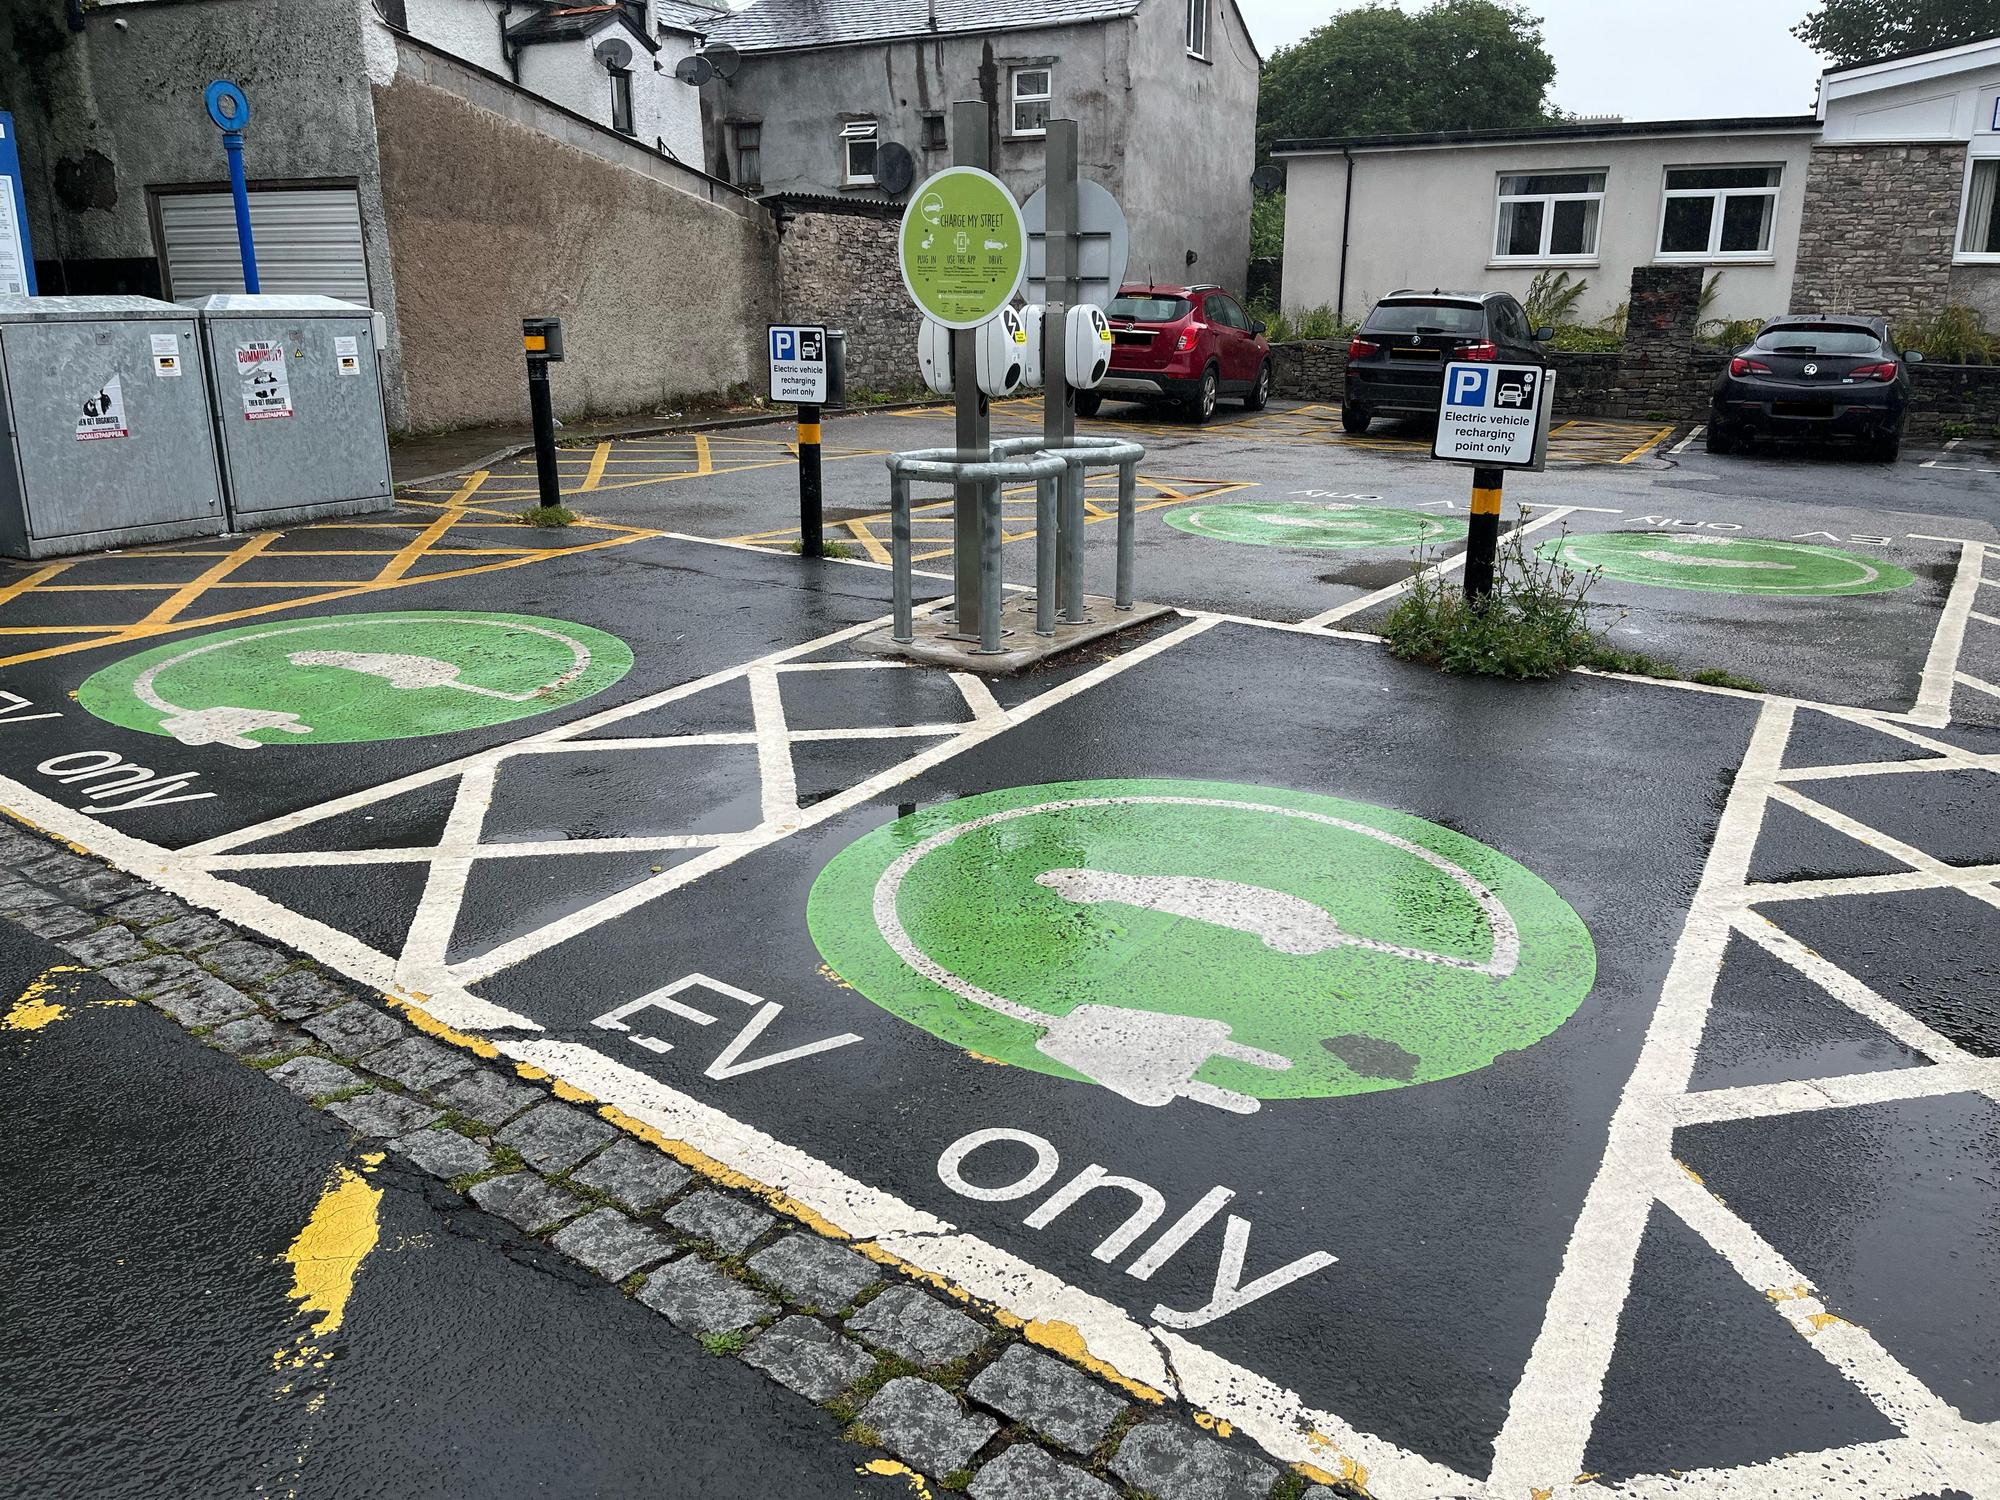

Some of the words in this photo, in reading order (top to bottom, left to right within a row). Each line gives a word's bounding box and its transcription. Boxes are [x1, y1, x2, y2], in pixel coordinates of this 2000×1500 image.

[940, 214, 966, 228] CHARGE
[967, 214, 979, 228] MY
[980, 213, 1004, 228] STREET
[930, 255, 937, 265] IN
[988, 255, 1004, 265] DRIVE
[776, 333, 791, 358] P
[773, 365, 799, 373] Electric
[800, 366, 823, 374] vehicle
[781, 376, 816, 386] recharging
[1454, 371, 1482, 403] P
[782, 388, 799, 396] point
[800, 388, 815, 397] only
[1445, 411, 1487, 423] Electric
[1490, 414, 1530, 426] vehicle
[1455, 427, 1515, 441] recharging
[1455, 442, 1484, 452] point
[1487, 443, 1511, 455] only
[1287, 489, 1384, 501] only
[1624, 515, 1743, 530] only
[1791, 531, 1892, 546] EV
[36, 750, 218, 814] only
[590, 972, 864, 1080] EV
[937, 1127, 1340, 1330] only
